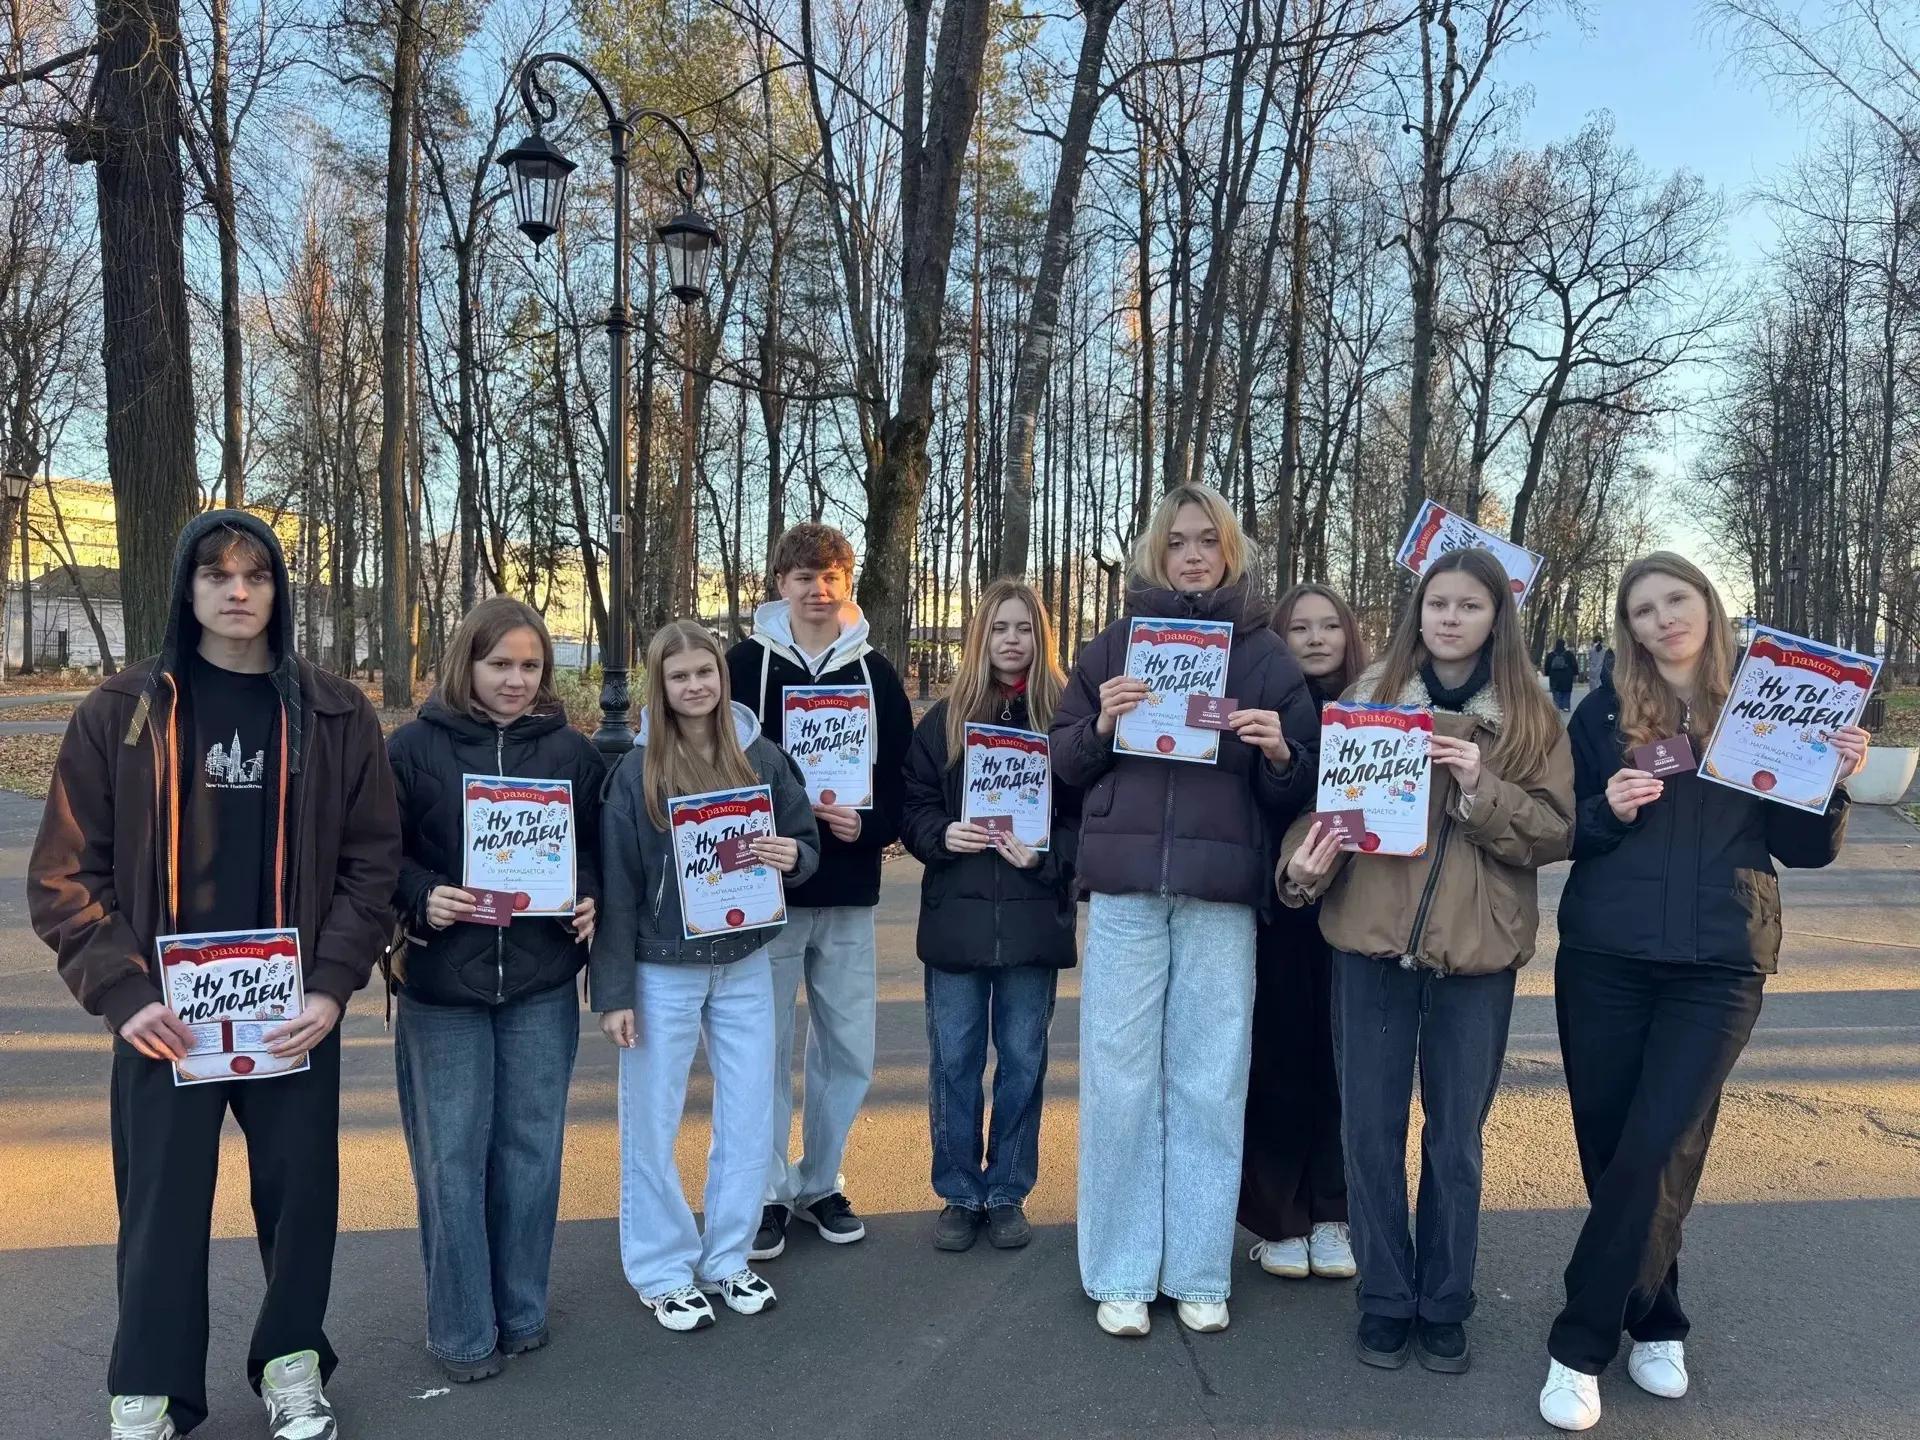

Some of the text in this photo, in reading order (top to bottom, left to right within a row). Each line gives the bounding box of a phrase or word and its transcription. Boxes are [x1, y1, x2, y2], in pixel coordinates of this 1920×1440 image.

[1156, 632, 1204, 645] Грамота
[1781, 651, 1842, 678] Грамота
[1141, 666, 1222, 693] ОЛОДЕЦ!
[808, 698, 848, 708] Грамота
[1350, 713, 1406, 727] Грамота
[1732, 701, 1855, 732] МОЛОДЕЦ!
[790, 724, 866, 756] МОЛОДЕЦ!
[988, 737, 1028, 750] Грамота
[1750, 741, 1803, 761] НАГРАЖДАЕТСЯ
[970, 769, 1046, 792] МОЛОДЕЦ!
[1322, 754, 1428, 787] МОЛОДЕЦ!
[494, 790, 546, 801] Грамота
[698, 806, 746, 819] Грамота
[473, 820, 568, 852] МОЛОДЕЦ!
[200, 946, 264, 960] Грамота
[179, 975, 294, 1023] МОЛОДЕЦ!
